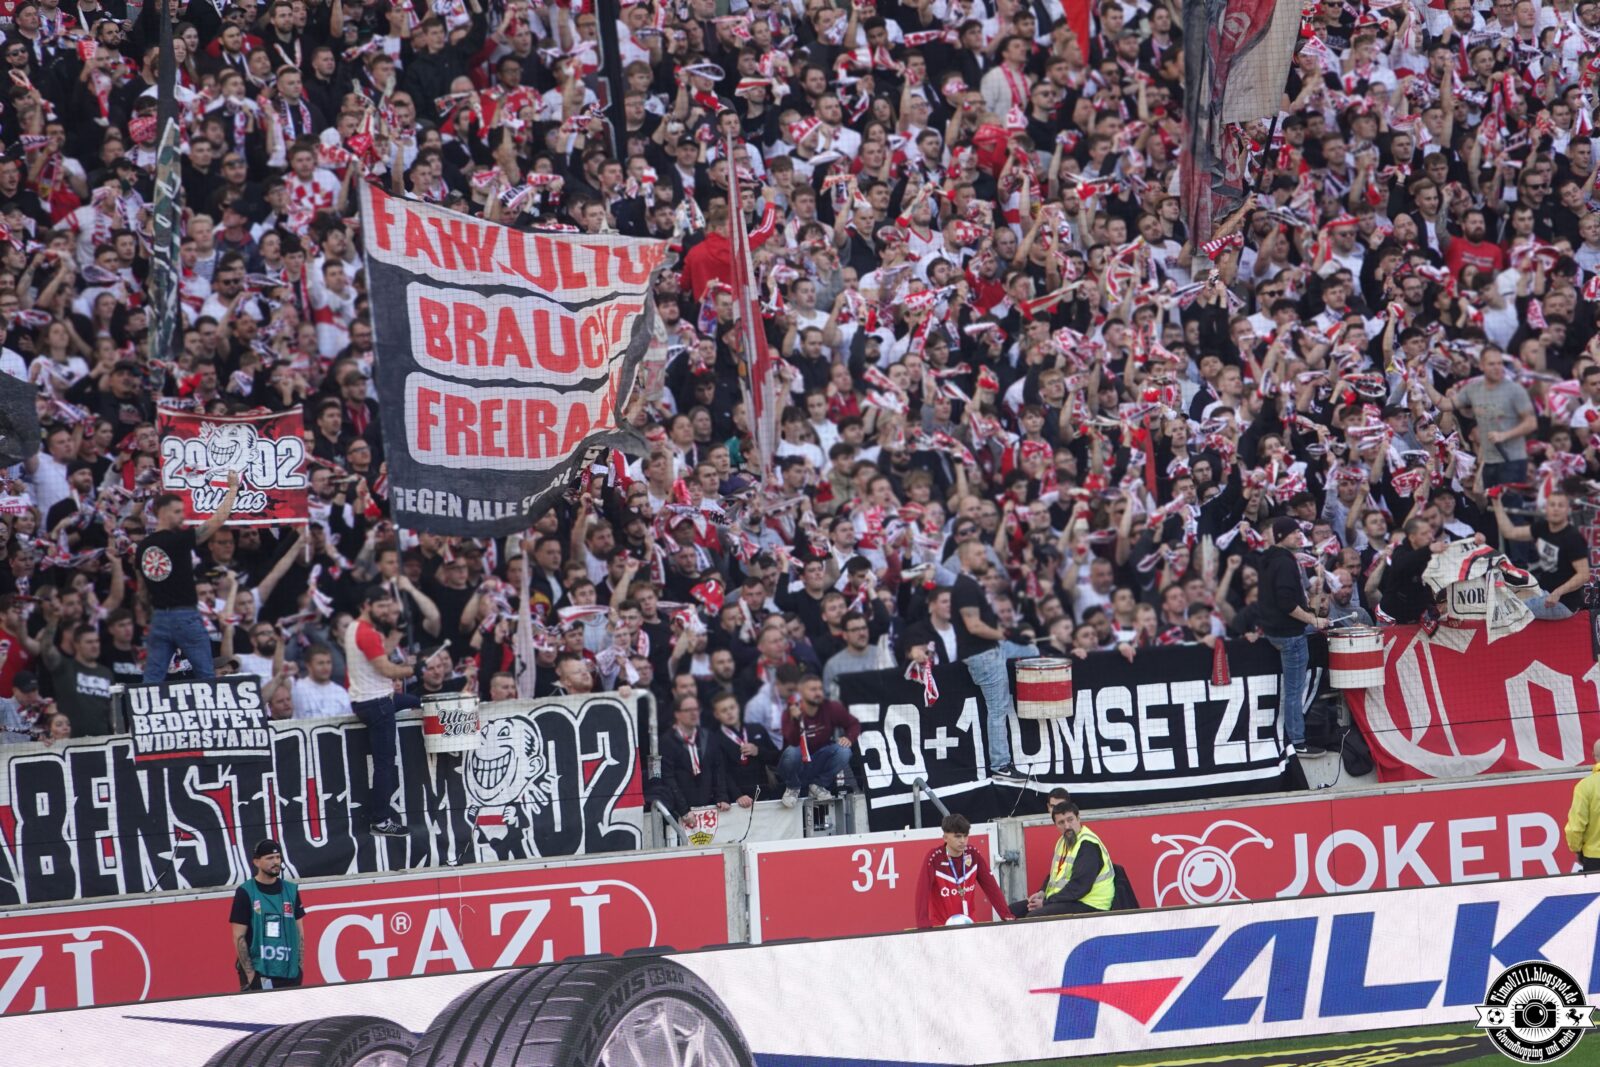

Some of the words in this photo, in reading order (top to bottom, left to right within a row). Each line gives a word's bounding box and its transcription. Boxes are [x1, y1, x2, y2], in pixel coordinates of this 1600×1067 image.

[194, 488, 267, 512] Ulas
[466, 500, 518, 522] ALLE
[128, 681, 261, 715] ULTRAS
[1364, 627, 1600, 778] Co
[132, 708, 264, 735] BEDEUTET
[134, 728, 269, 753] WIDERSTAND
[847, 696, 987, 790] 50+1
[851, 847, 900, 893] 34
[1275, 812, 1583, 898] JOKER
[1030, 892, 1600, 1042] FALK
